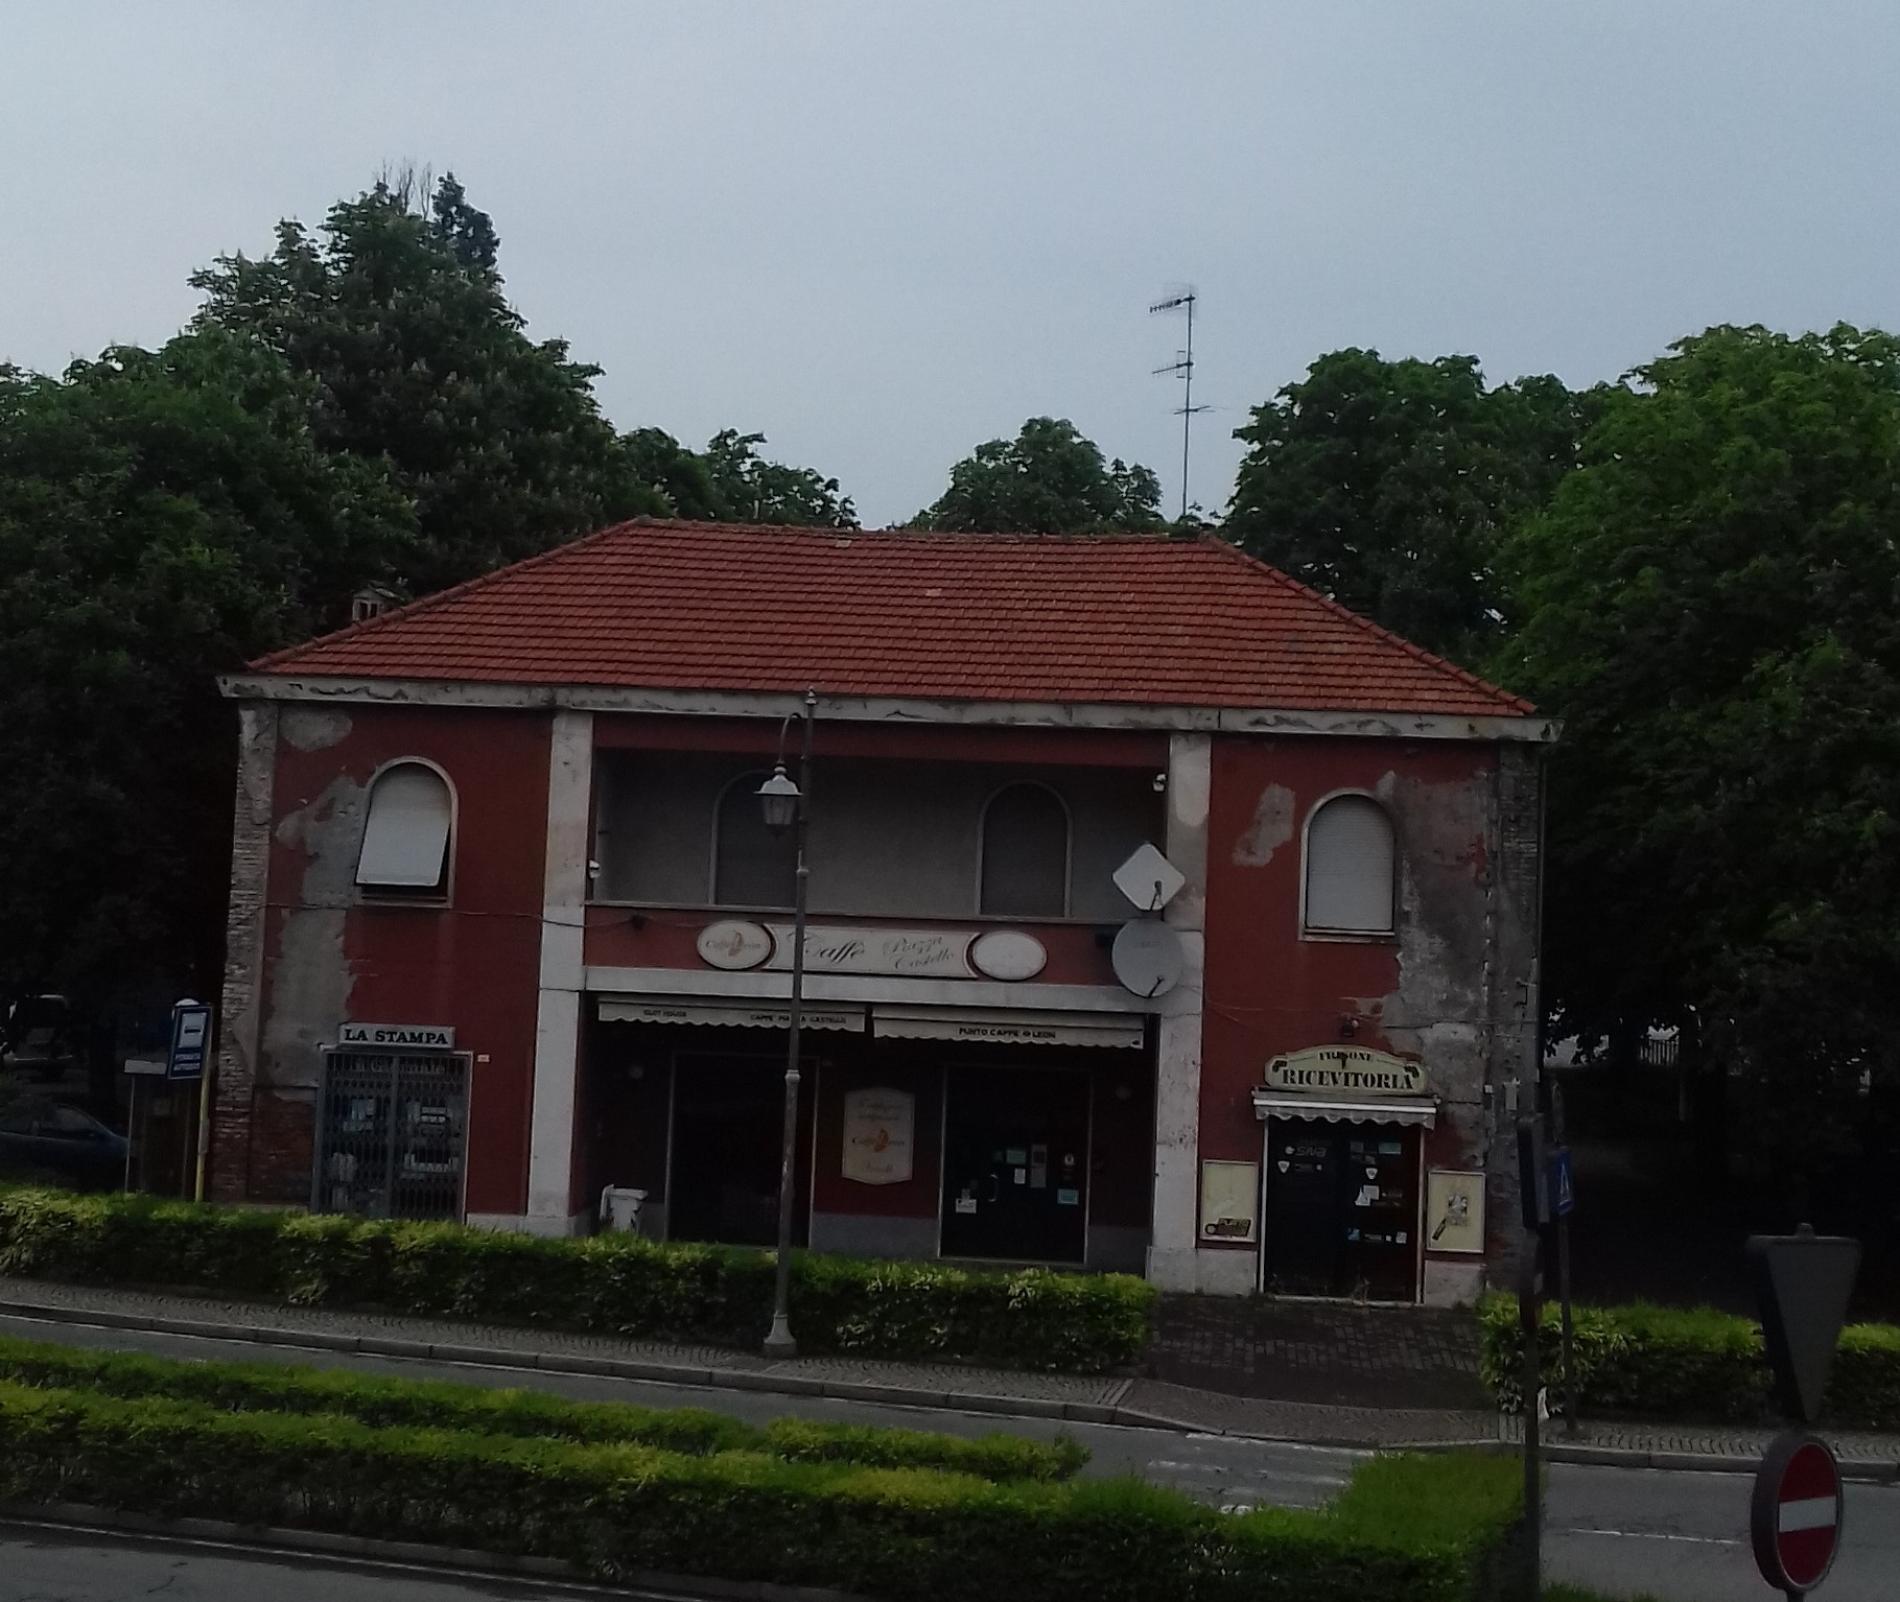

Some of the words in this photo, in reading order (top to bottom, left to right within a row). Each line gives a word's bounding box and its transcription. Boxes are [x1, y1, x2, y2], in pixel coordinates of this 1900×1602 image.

[344, 1028, 368, 1042] LA
[375, 1029, 449, 1045] STAMPA
[1281, 1069, 1415, 1090] RICEVITORIA
